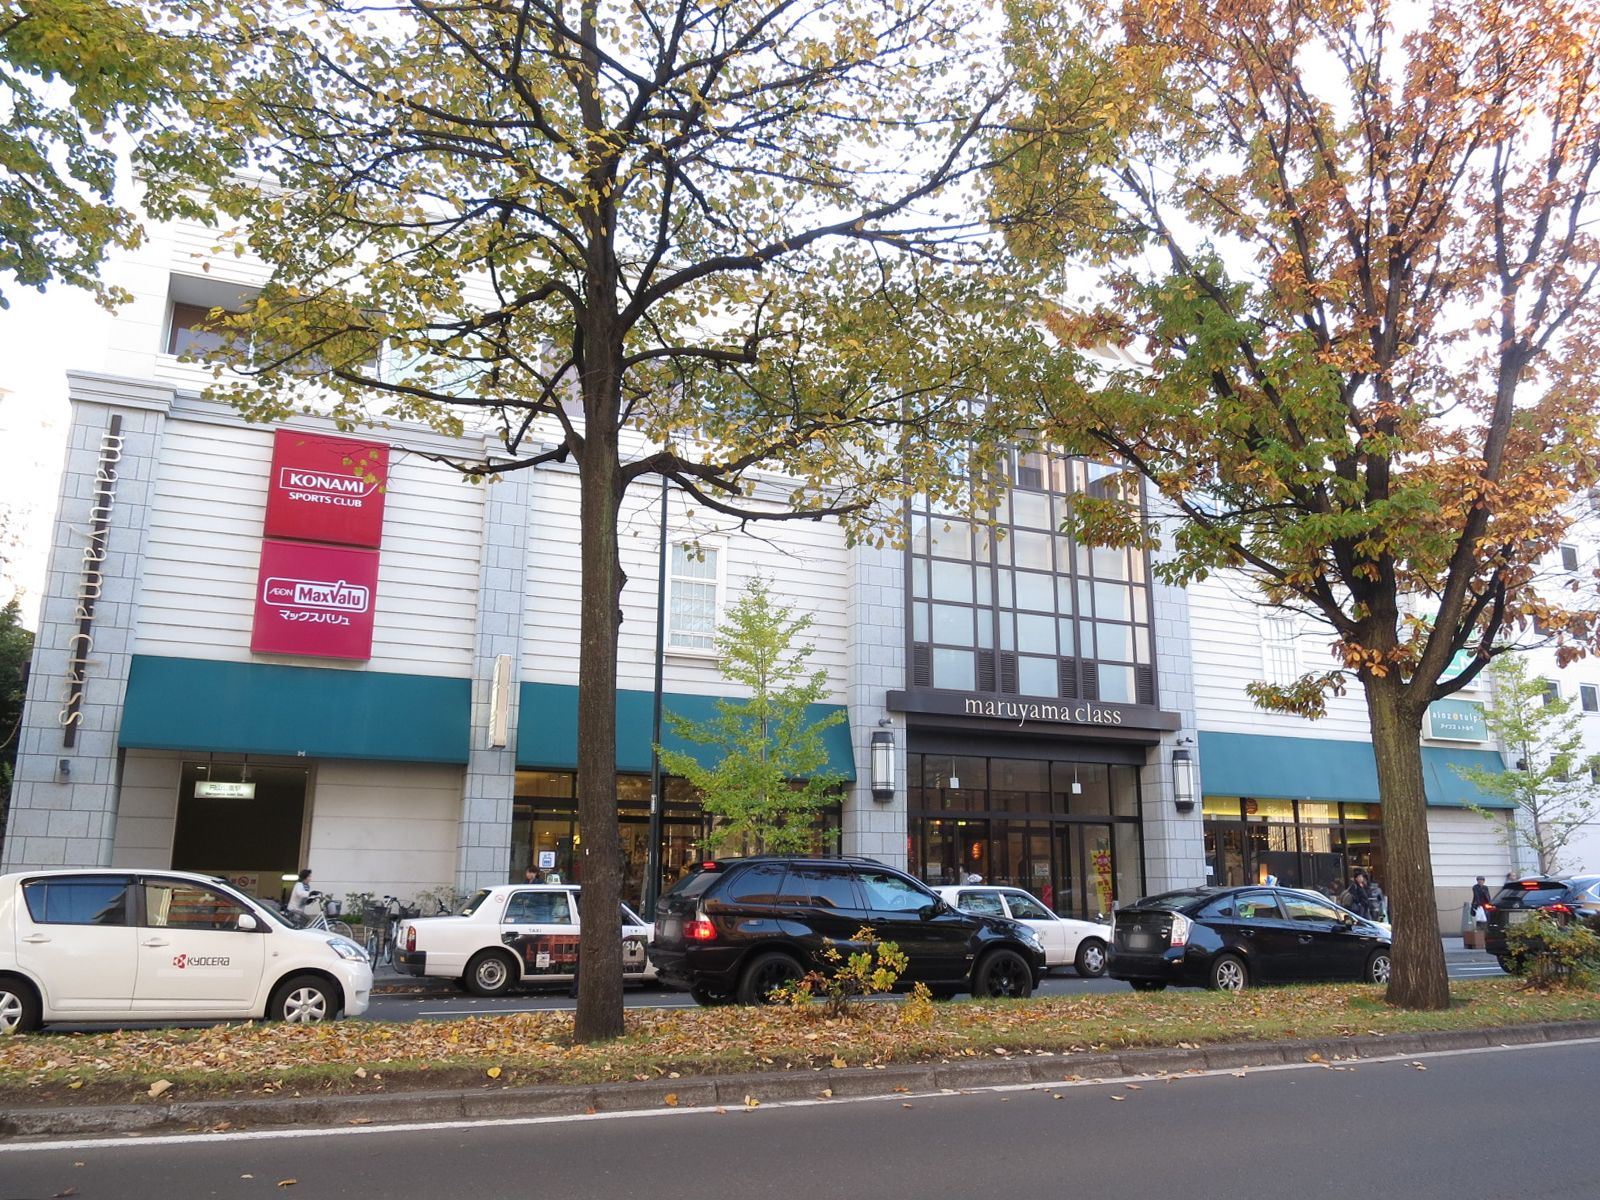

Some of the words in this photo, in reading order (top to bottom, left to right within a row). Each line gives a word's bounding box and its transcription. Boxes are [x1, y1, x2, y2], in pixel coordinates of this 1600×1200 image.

[290, 473, 364, 493] KONAMI
[288, 491, 331, 504] SPORTS
[333, 497, 362, 508] CLUB
[69, 432, 127, 622] maruyama
[298, 581, 361, 605] MaxValu
[279, 609, 350, 625] マックスバリュ
[58, 633, 103, 726] class
[965, 698, 1070, 727] maruyama
[1075, 703, 1122, 725] class
[187, 956, 230, 967] KYOCERA
